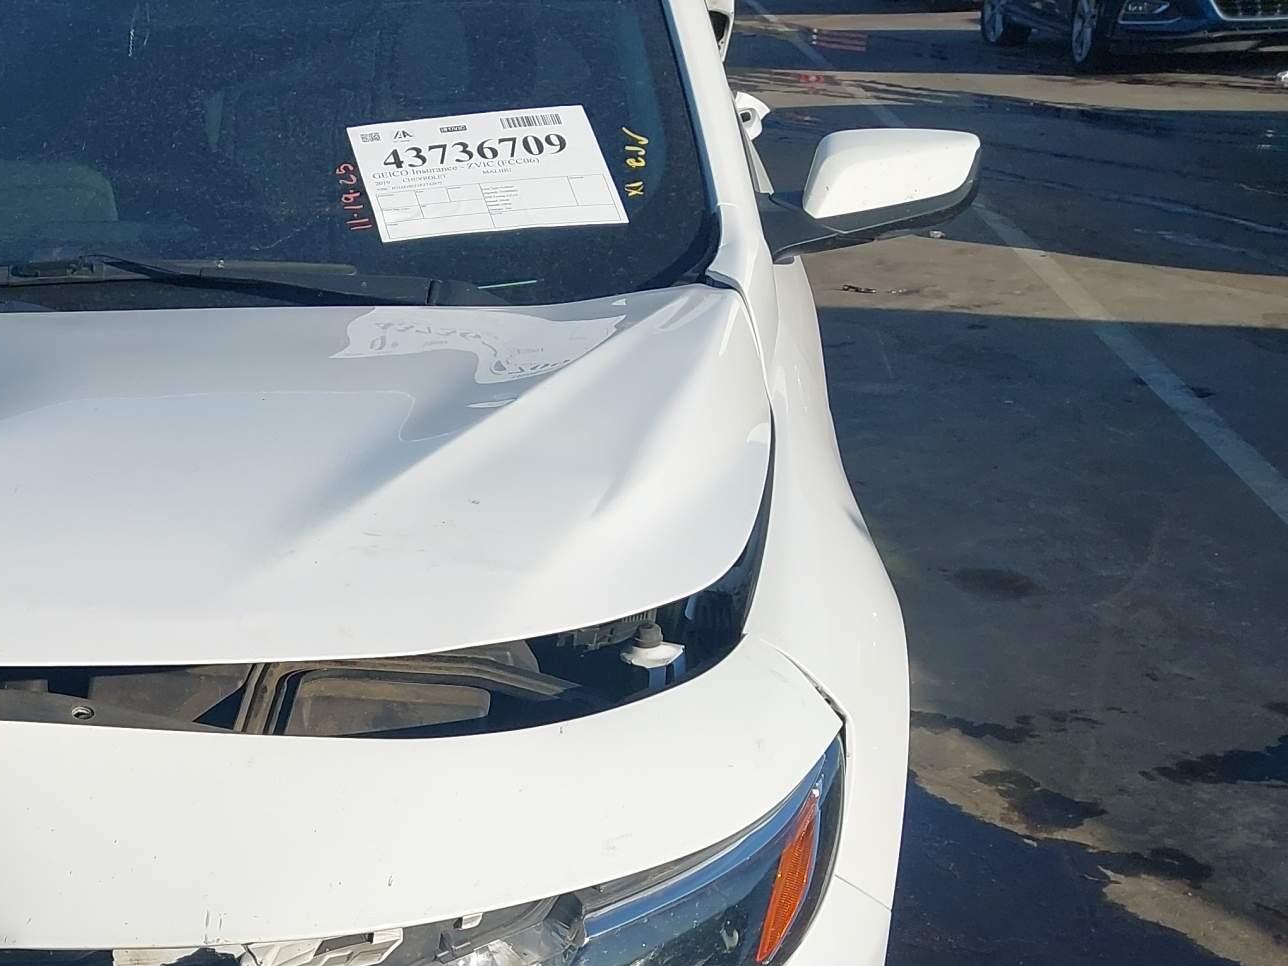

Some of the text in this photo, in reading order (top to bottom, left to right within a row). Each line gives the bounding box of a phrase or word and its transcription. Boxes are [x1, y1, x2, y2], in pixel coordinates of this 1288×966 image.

[383, 133, 567, 169] 43736709
[372, 169, 409, 180] GEICO
[411, 165, 458, 176] Insurance
